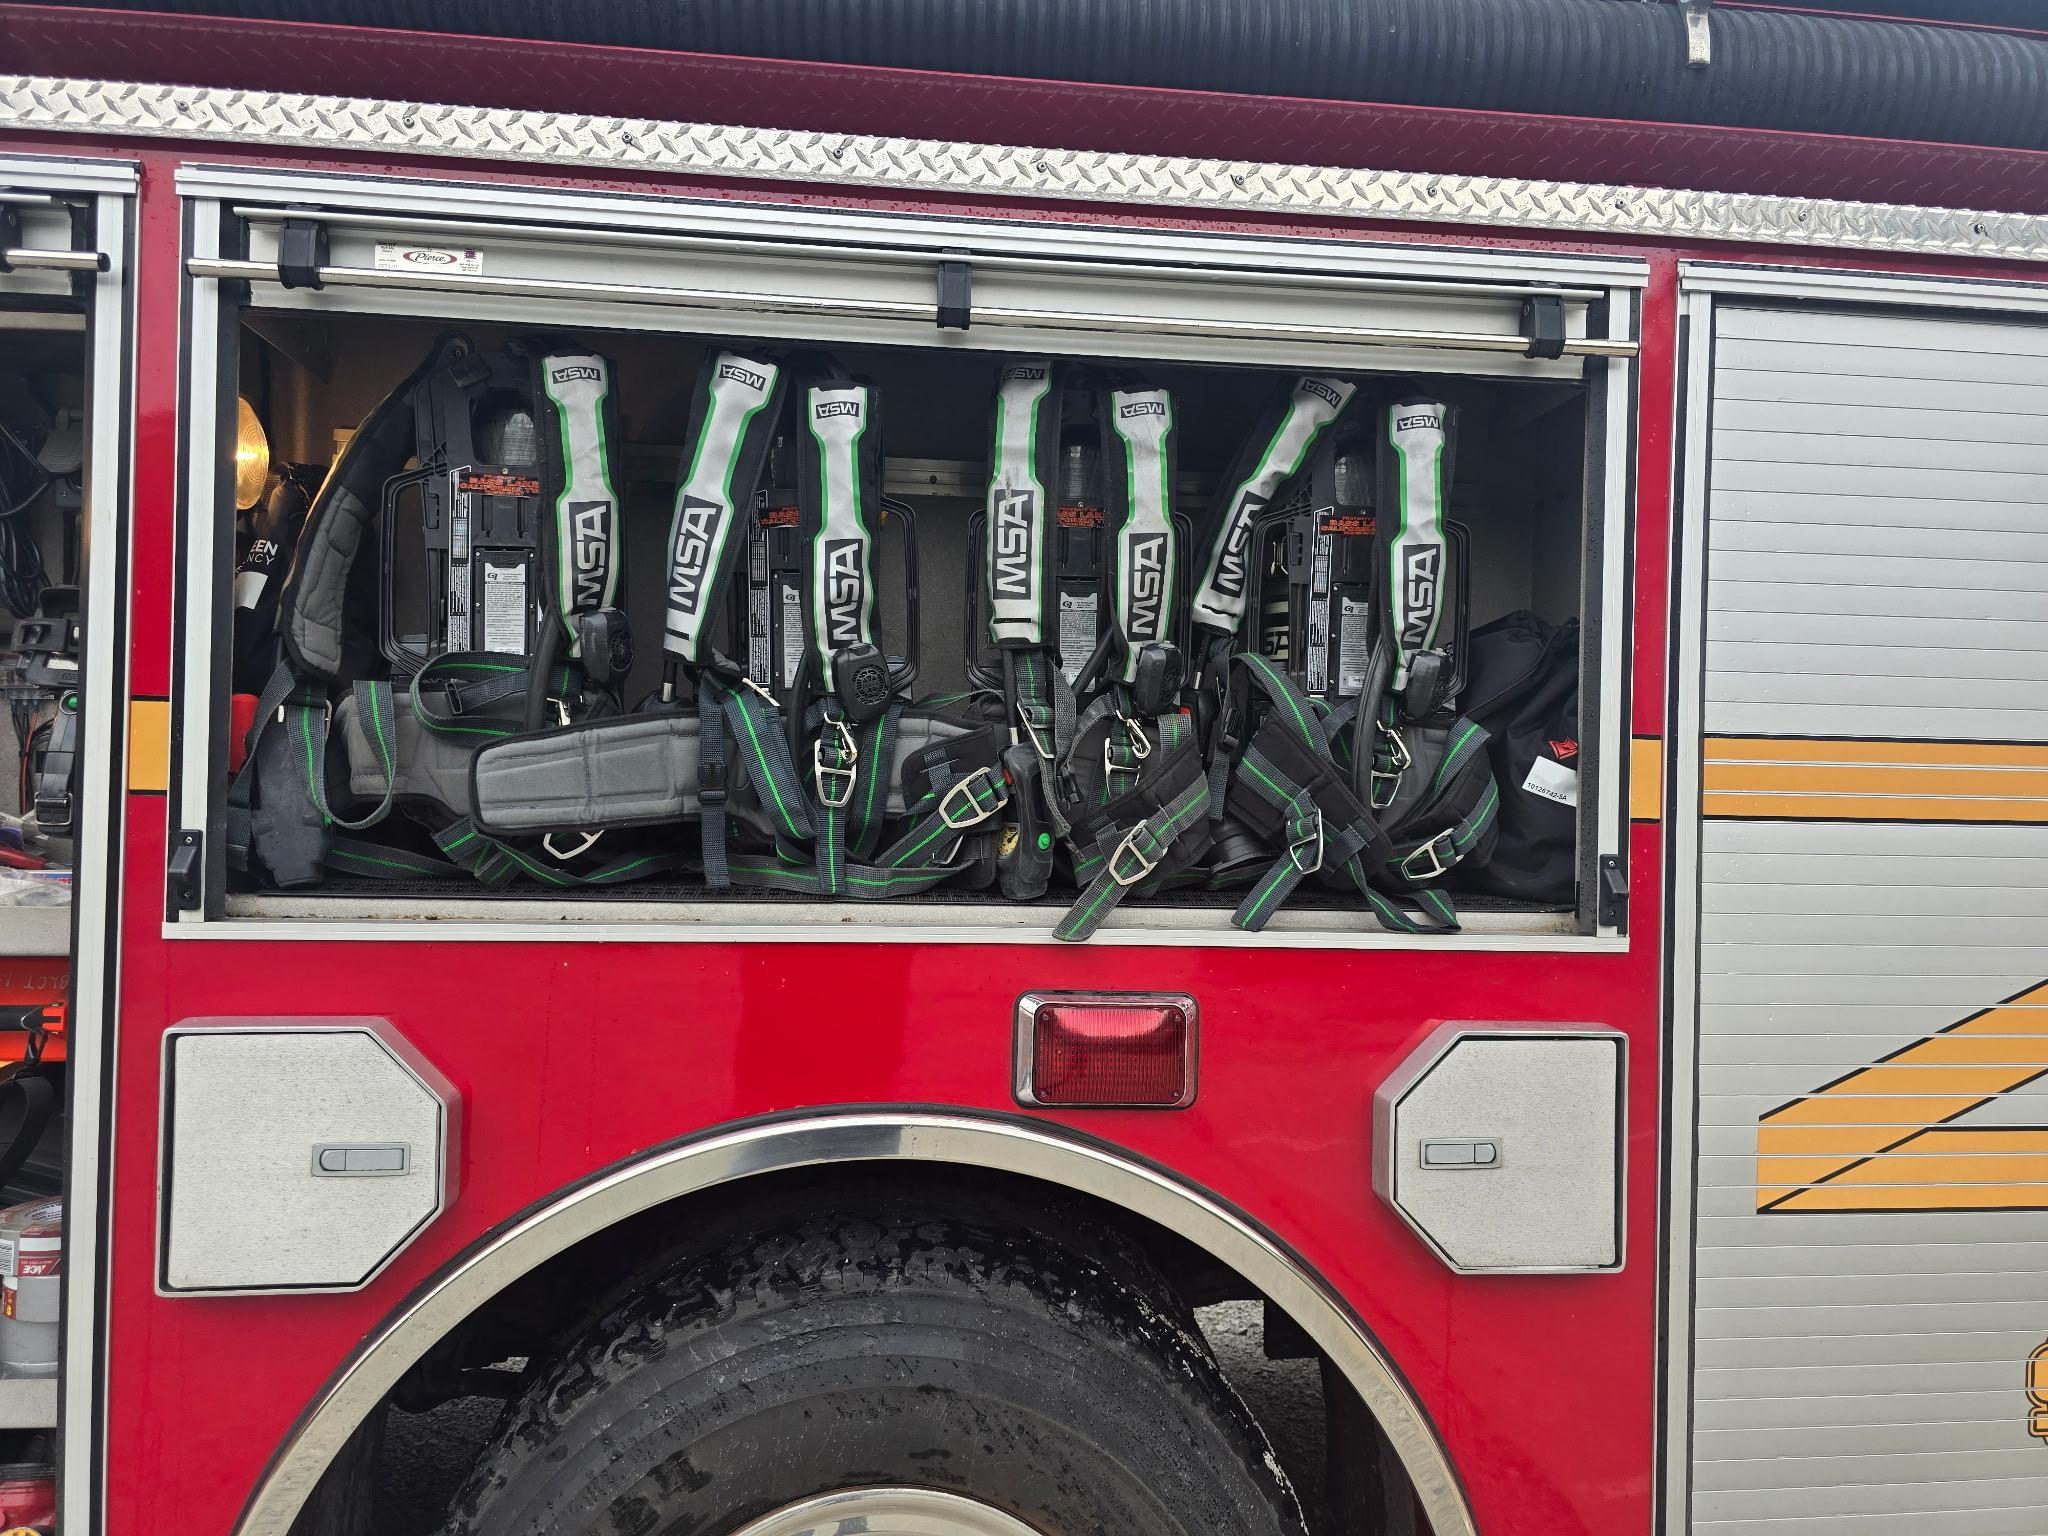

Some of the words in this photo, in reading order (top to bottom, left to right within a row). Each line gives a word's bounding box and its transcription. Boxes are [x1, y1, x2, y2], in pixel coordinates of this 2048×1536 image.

[415, 252, 445, 263] Pierce
[554, 367, 598, 382] MSA
[722, 365, 764, 388] MSA
[1305, 380, 1340, 406] MSA
[817, 402, 857, 417] MSA
[1122, 403, 1163, 417] MSA
[1398, 416, 1439, 430] MSA
[575, 505, 607, 606] MSA
[997, 493, 1029, 594] MSA
[669, 507, 717, 608] MSA
[829, 542, 860, 641] MSA
[1132, 536, 1164, 635] MSA
[1404, 547, 1437, 644] MSA
[22, 1264, 47, 1275] ACE
